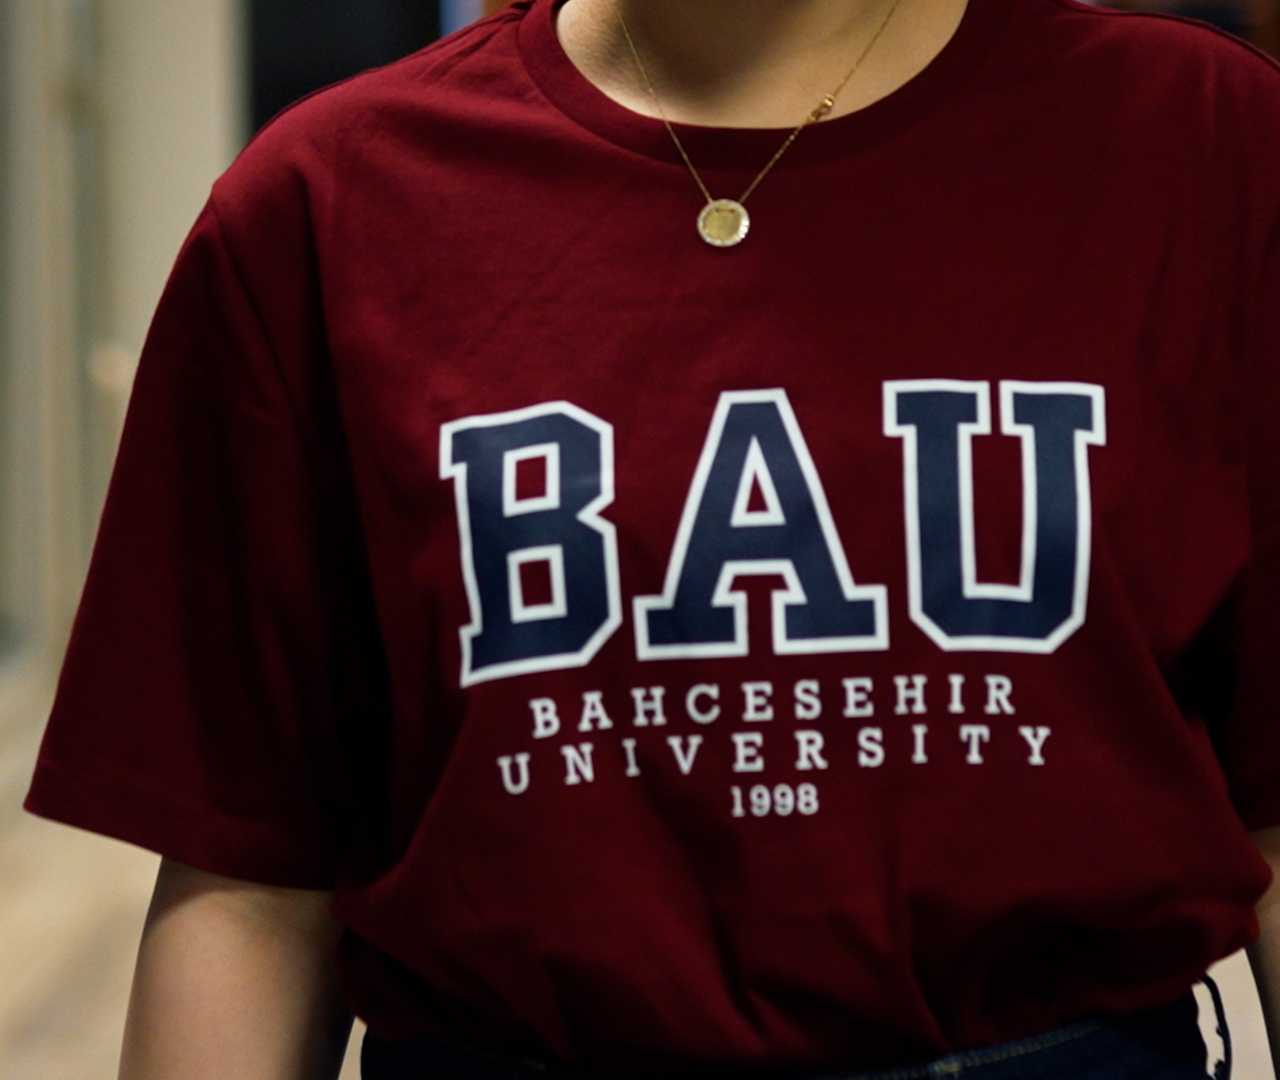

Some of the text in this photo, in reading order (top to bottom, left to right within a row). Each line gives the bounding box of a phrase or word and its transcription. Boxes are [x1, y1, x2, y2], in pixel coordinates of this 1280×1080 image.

[438, 378, 1107, 689] BAU
[529, 673, 1016, 739] BAHCESEHIR
[497, 723, 1051, 795] UNIVERSITY
[731, 782, 820, 818] 1998
